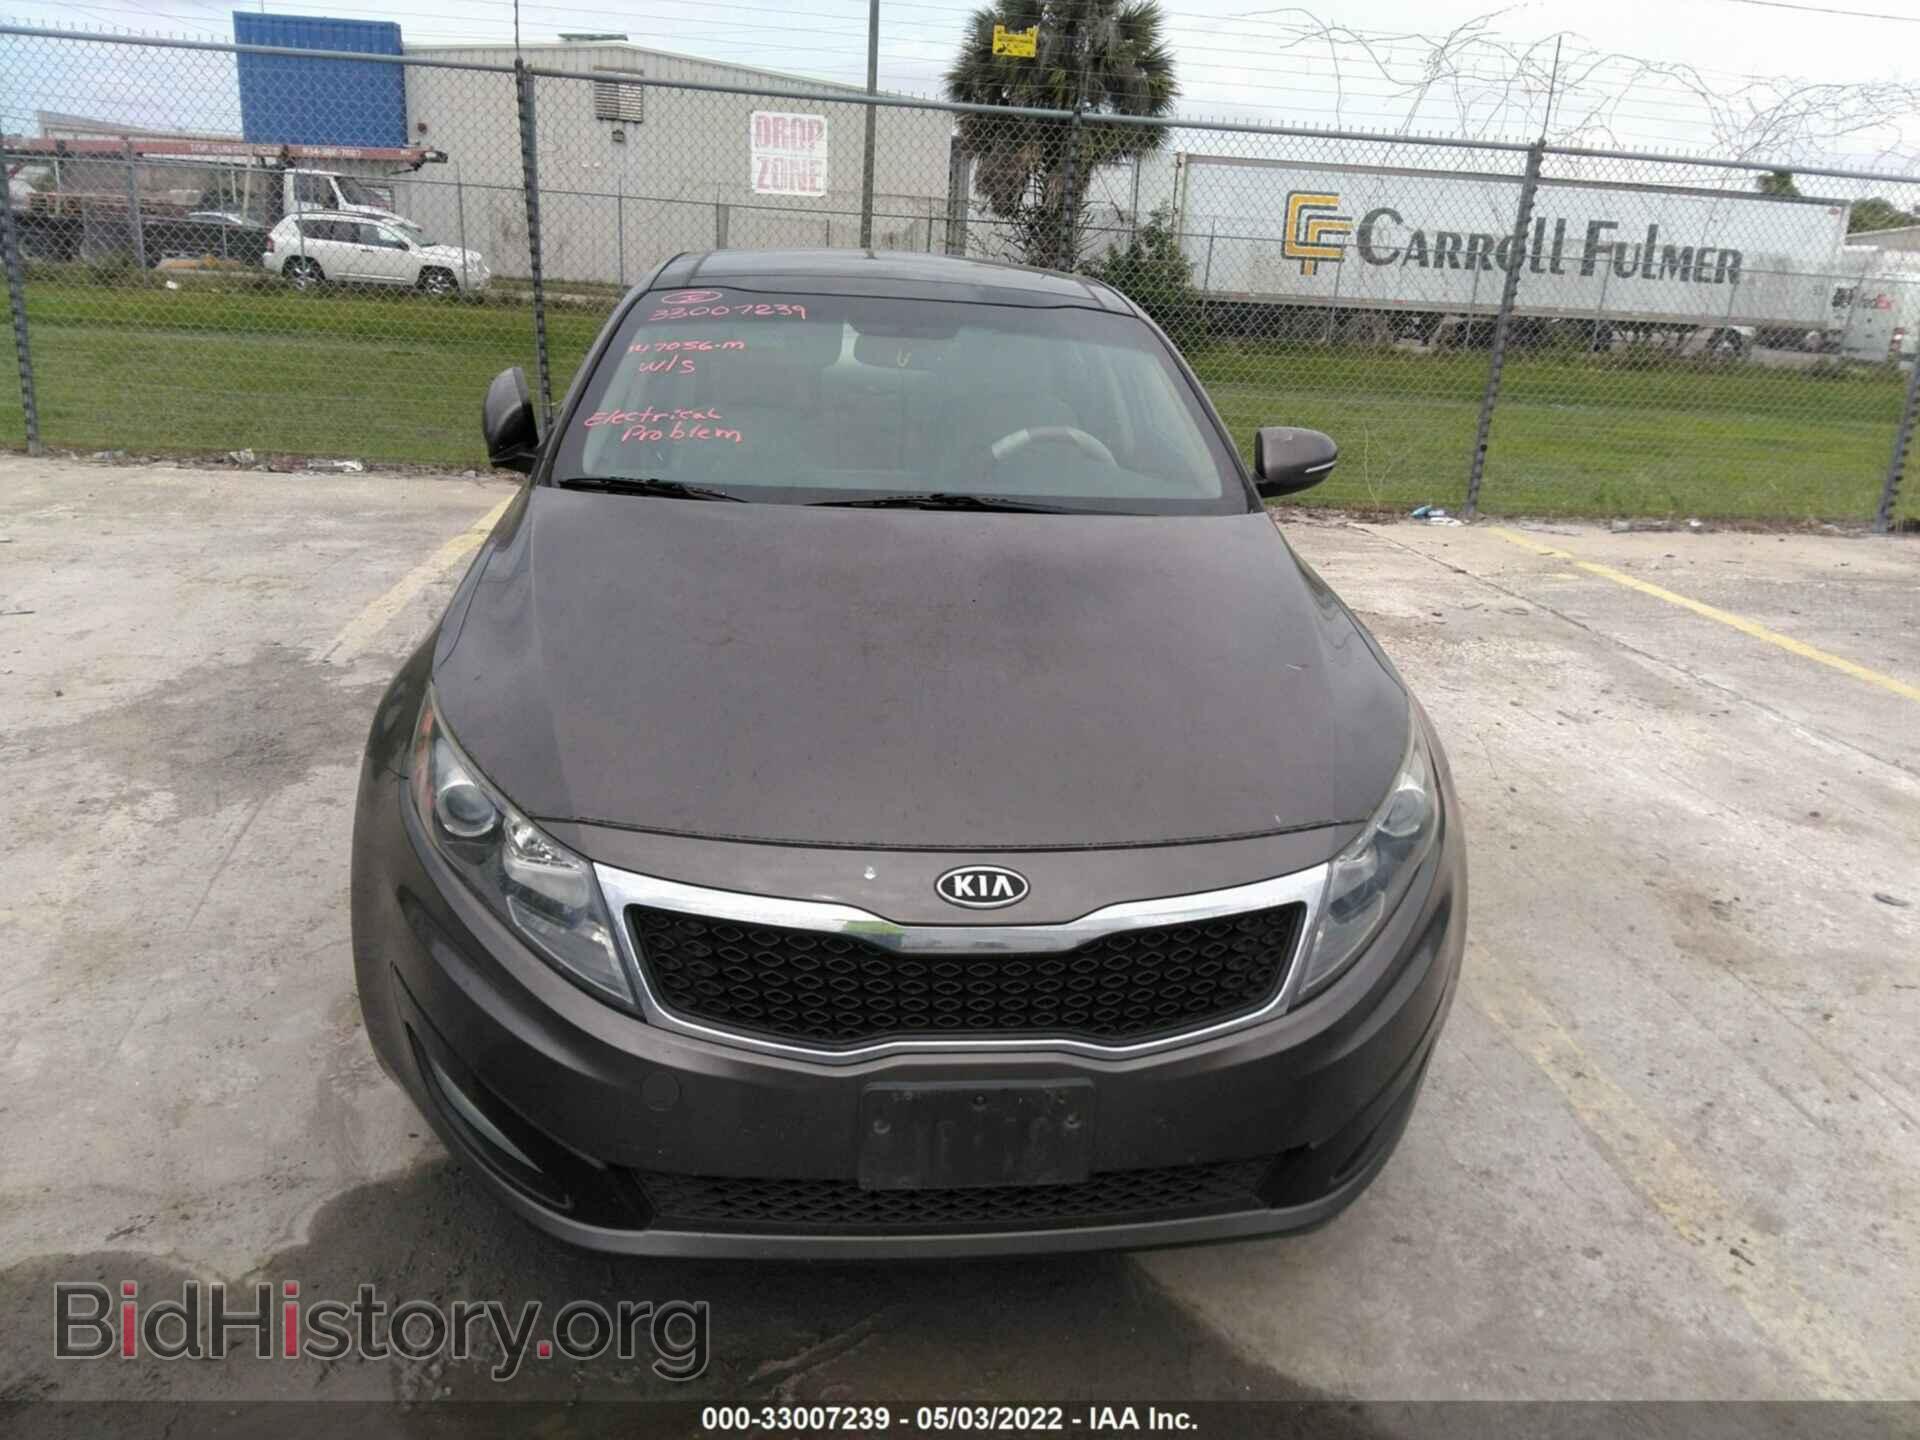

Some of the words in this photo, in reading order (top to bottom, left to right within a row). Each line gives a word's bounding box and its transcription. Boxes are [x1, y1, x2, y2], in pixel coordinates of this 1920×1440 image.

[755, 115, 824, 149] DROP
[757, 158, 823, 192] ZONE
[650, 303, 807, 321] 33007239
[583, 406, 722, 427] Electrical
[622, 420, 743, 443] Problem
[954, 875, 1014, 897] KIA
